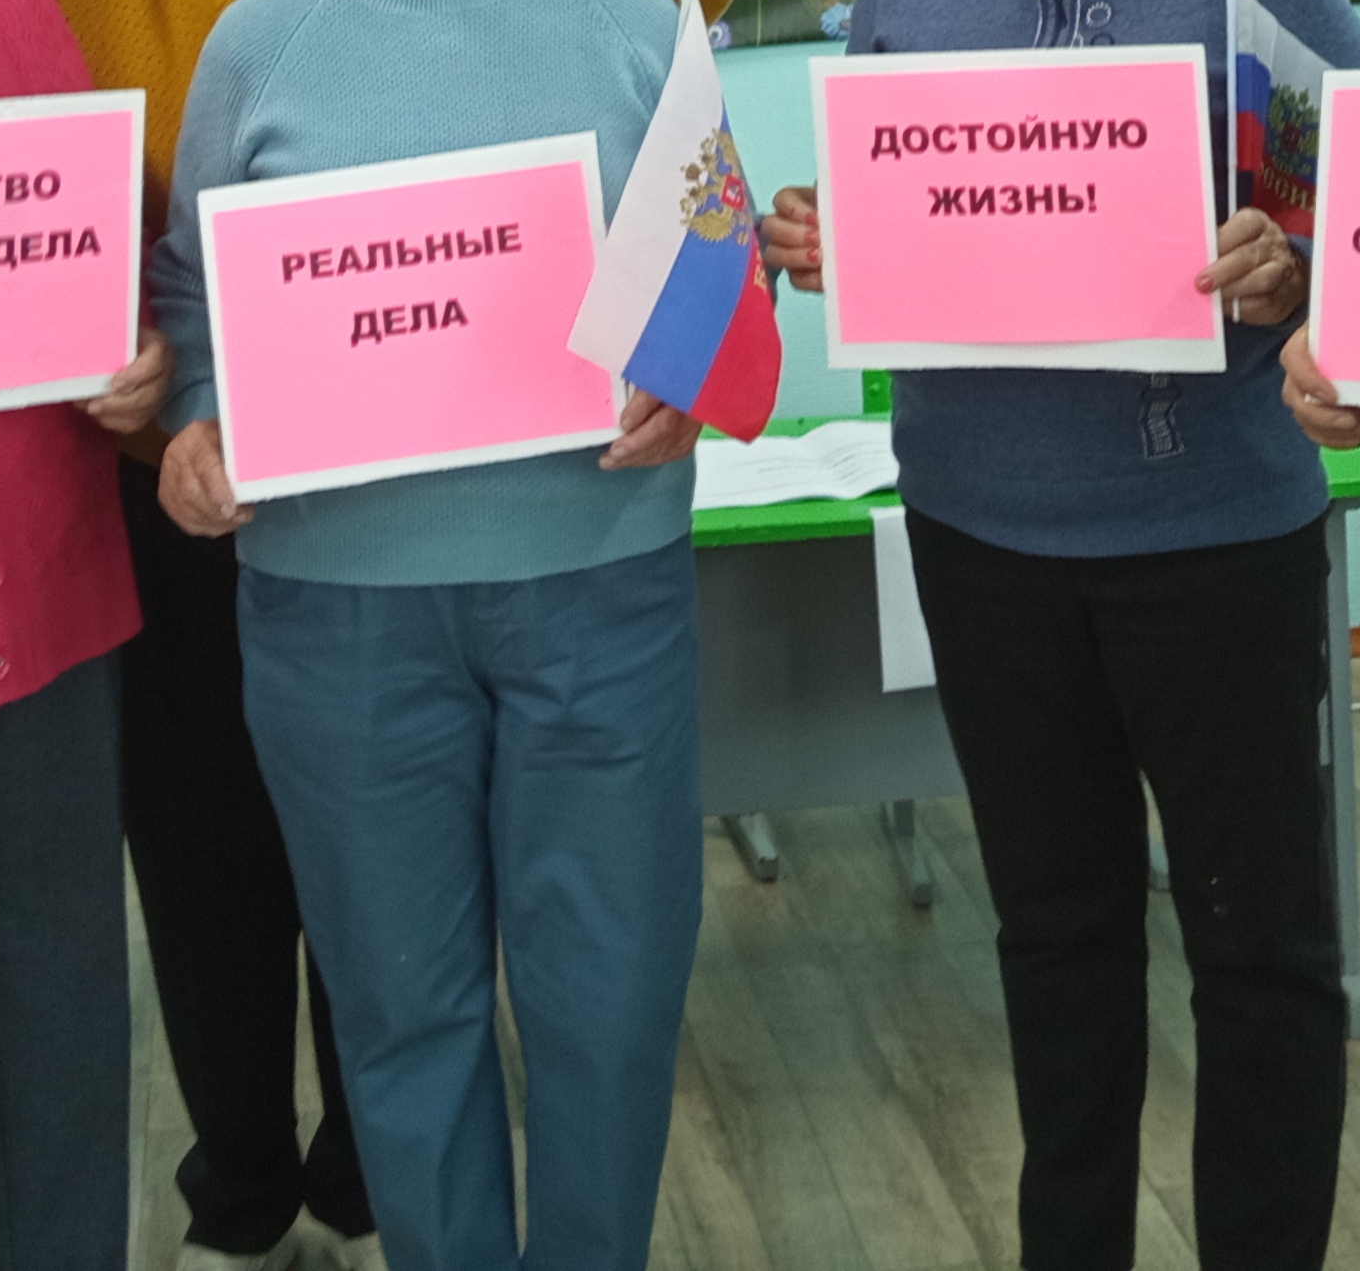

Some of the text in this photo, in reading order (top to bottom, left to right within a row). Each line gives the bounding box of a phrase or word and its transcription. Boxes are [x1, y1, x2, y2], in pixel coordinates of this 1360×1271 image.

[870, 113, 1148, 161] ДОСТОЙНУЮ
[928, 183, 1097, 217] ЖИЗНЬ!
[281, 223, 522, 283] РЕАЛЬНЫЕ
[350, 298, 468, 347] ДЕЛА
